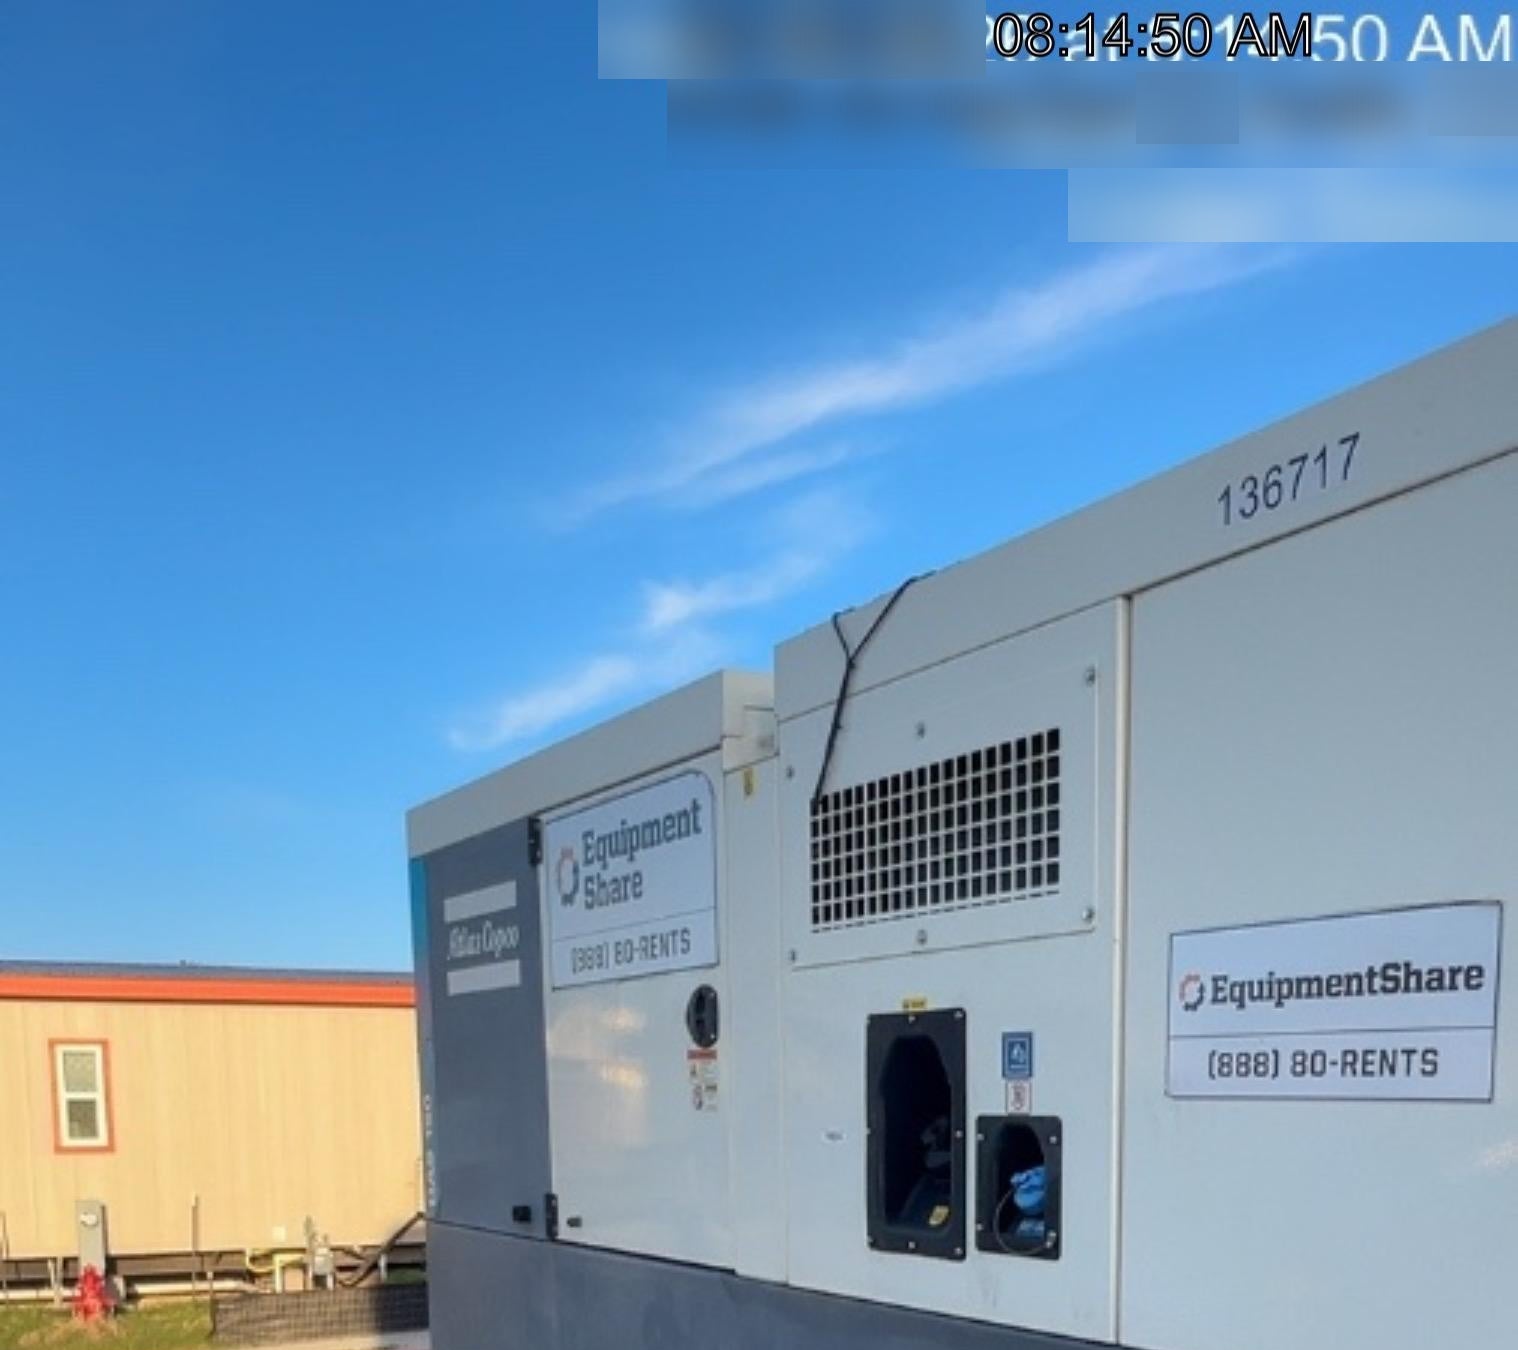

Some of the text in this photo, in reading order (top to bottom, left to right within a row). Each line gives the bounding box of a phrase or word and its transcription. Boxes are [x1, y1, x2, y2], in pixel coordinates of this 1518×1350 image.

[1217, 432, 1361, 526] 136717
[581, 798, 703, 871] Equipment
[583, 868, 644, 911] Share
[1210, 959, 1485, 1009] EquipmentShare
[1208, 1047, 1439, 1081] (888) 80-RENTS
